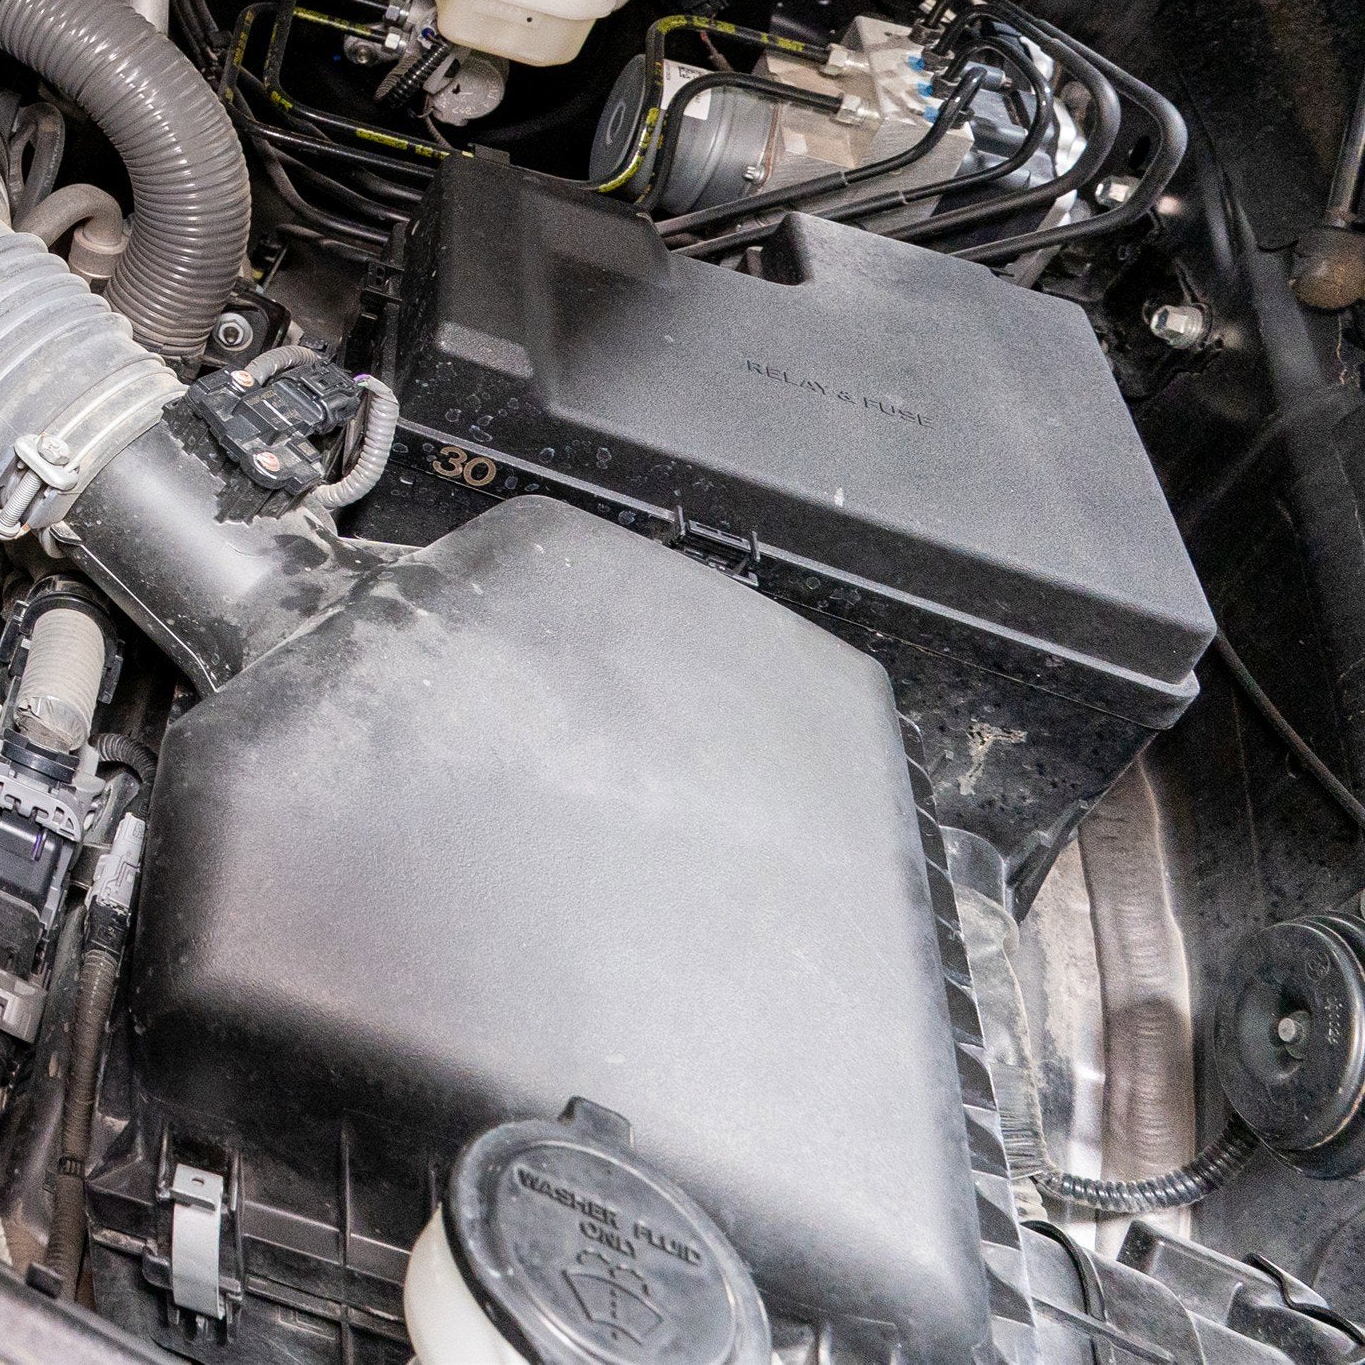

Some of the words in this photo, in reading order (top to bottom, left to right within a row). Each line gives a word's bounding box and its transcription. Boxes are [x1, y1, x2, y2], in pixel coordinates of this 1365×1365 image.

[746, 359, 828, 395] RELAY
[836, 389, 857, 405] &
[863, 396, 939, 430] FUSE
[432, 446, 497, 487] 30
[517, 1168, 619, 1230] WASHER
[632, 1221, 701, 1267] FLUID
[578, 1220, 637, 1259] ONLY
